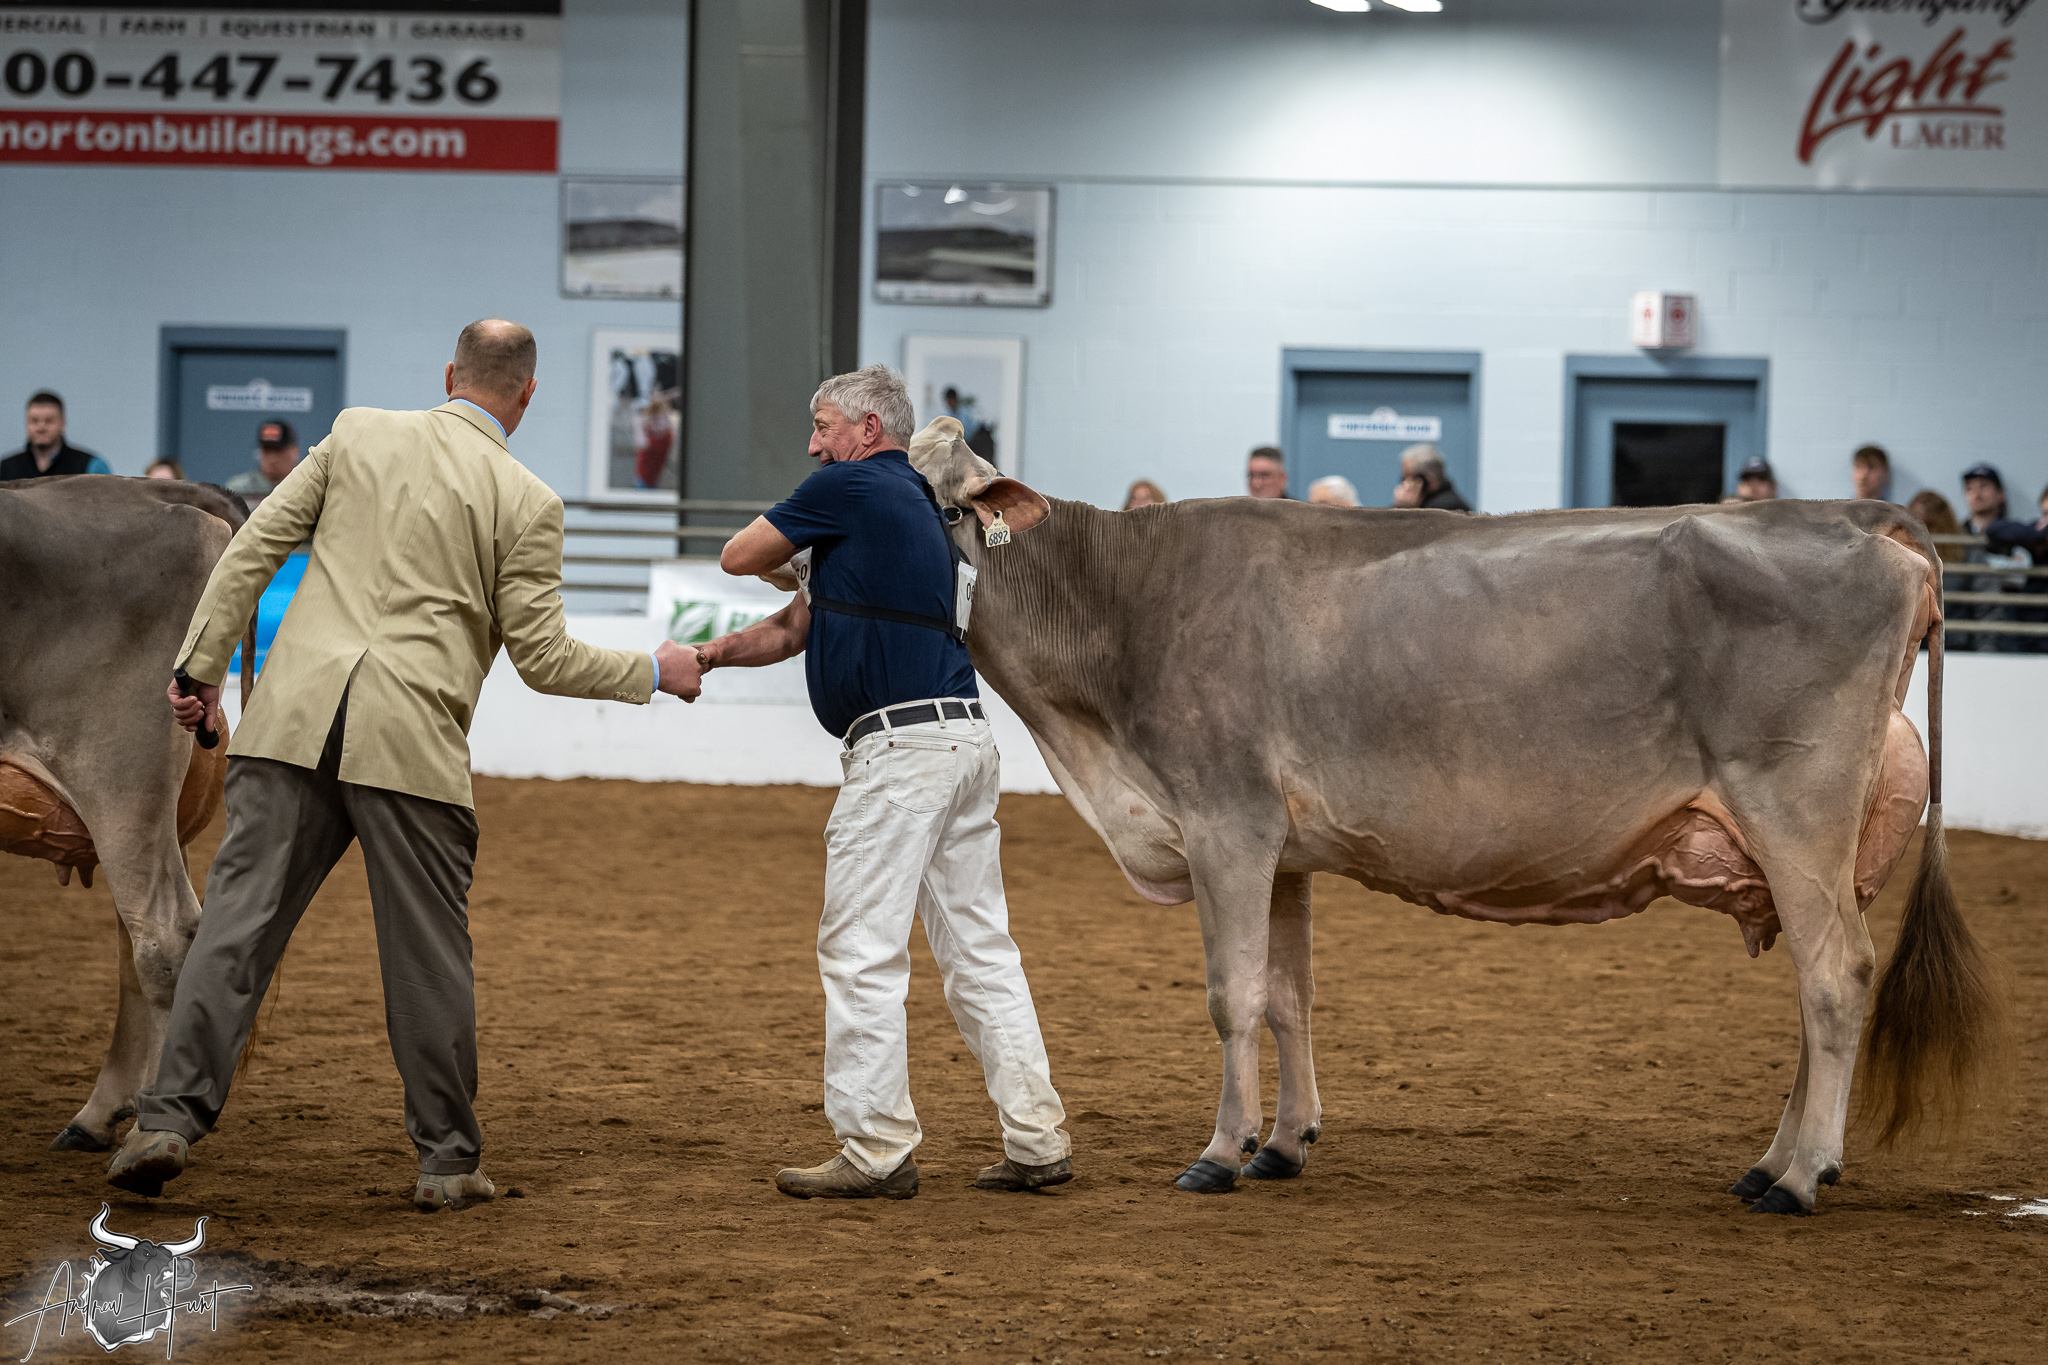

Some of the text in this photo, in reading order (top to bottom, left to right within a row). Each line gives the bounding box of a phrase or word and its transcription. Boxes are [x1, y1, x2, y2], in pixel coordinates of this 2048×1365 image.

[0, 15, 524, 40] ERCIAL FARM EQUESTRIAN GARAGES
[4, 51, 501, 106] 00-447-7436
[1797, 26, 2013, 164] Light
[1890, 121, 2004, 150] LAGER
[988, 530, 1009, 546] 6892
